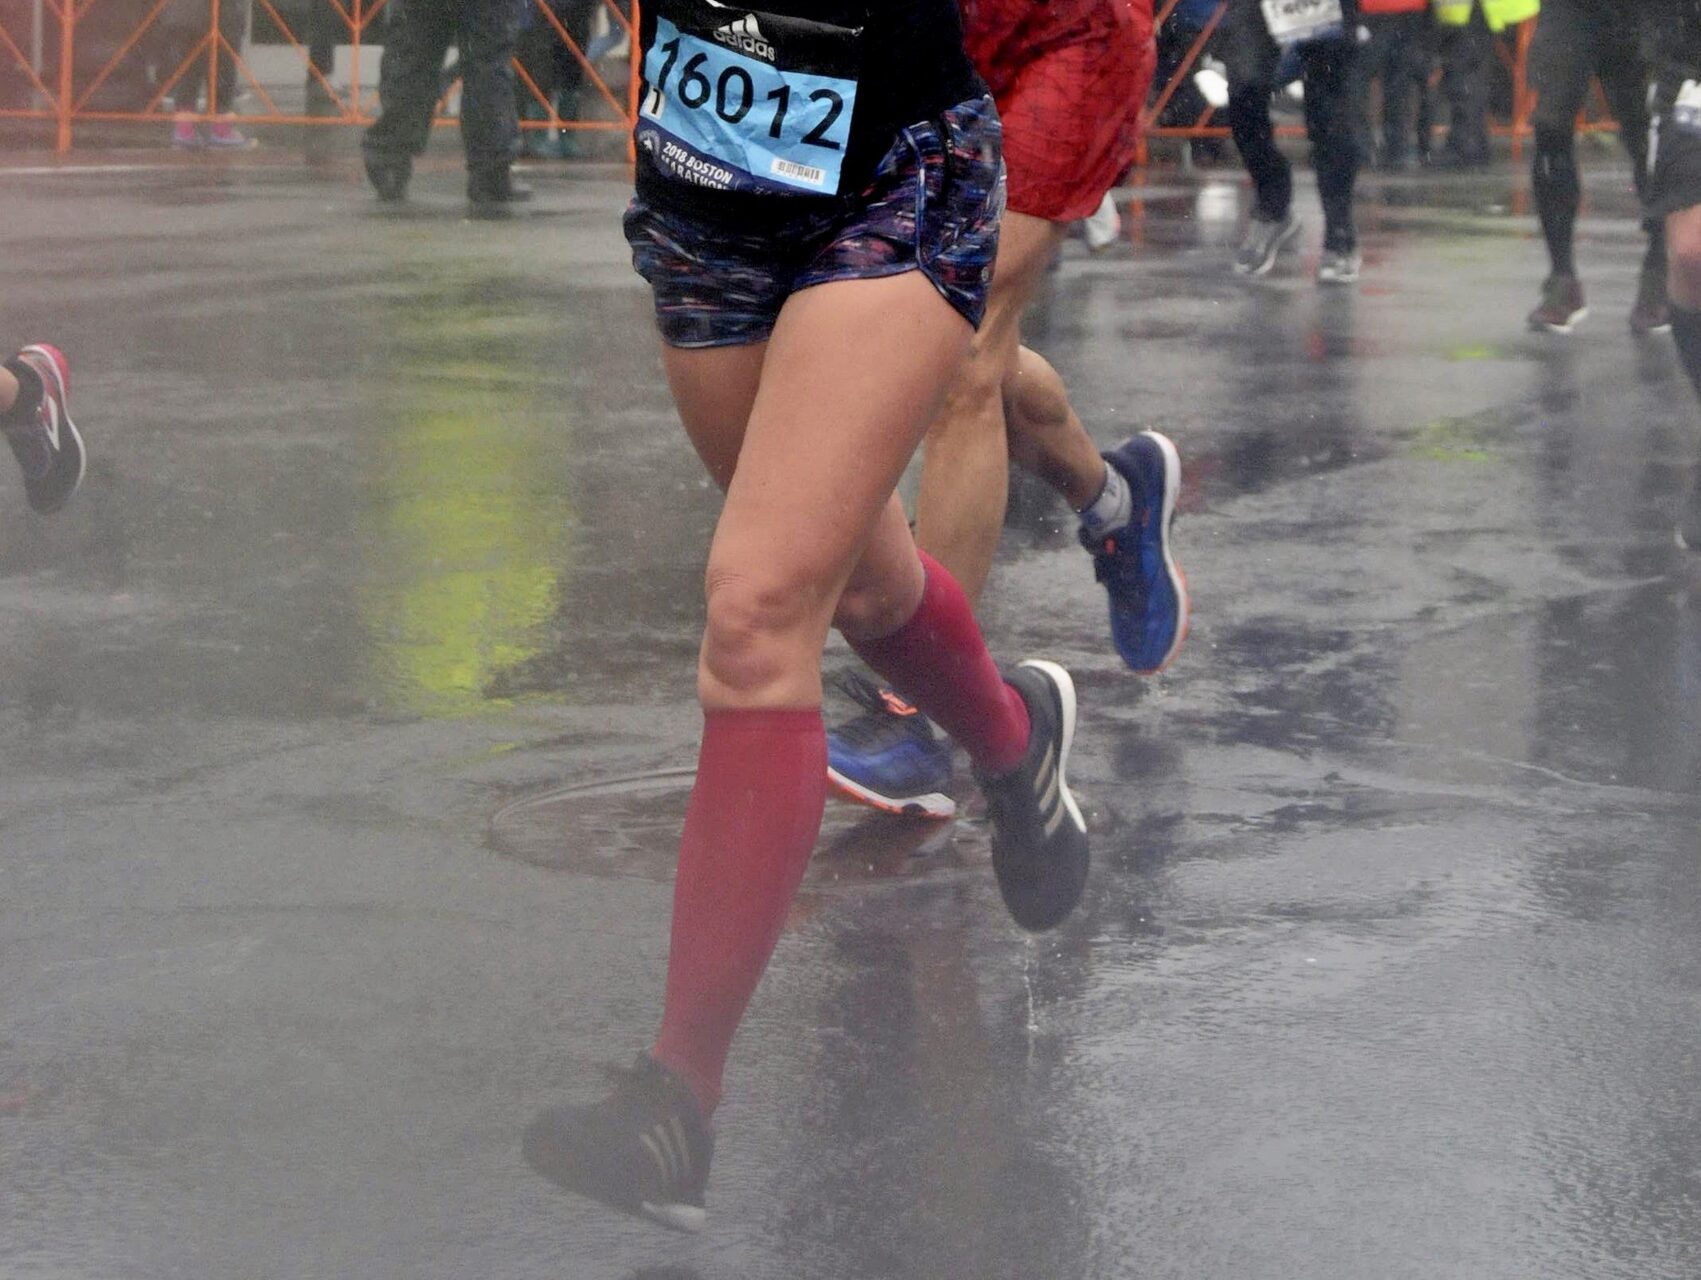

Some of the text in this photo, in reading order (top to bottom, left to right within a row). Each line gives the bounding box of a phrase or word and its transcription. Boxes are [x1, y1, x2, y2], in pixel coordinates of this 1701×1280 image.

[713, 30, 775, 61] adidas
[656, 37, 845, 151] 16012
[663, 141, 734, 184] 2018 BOSTON
